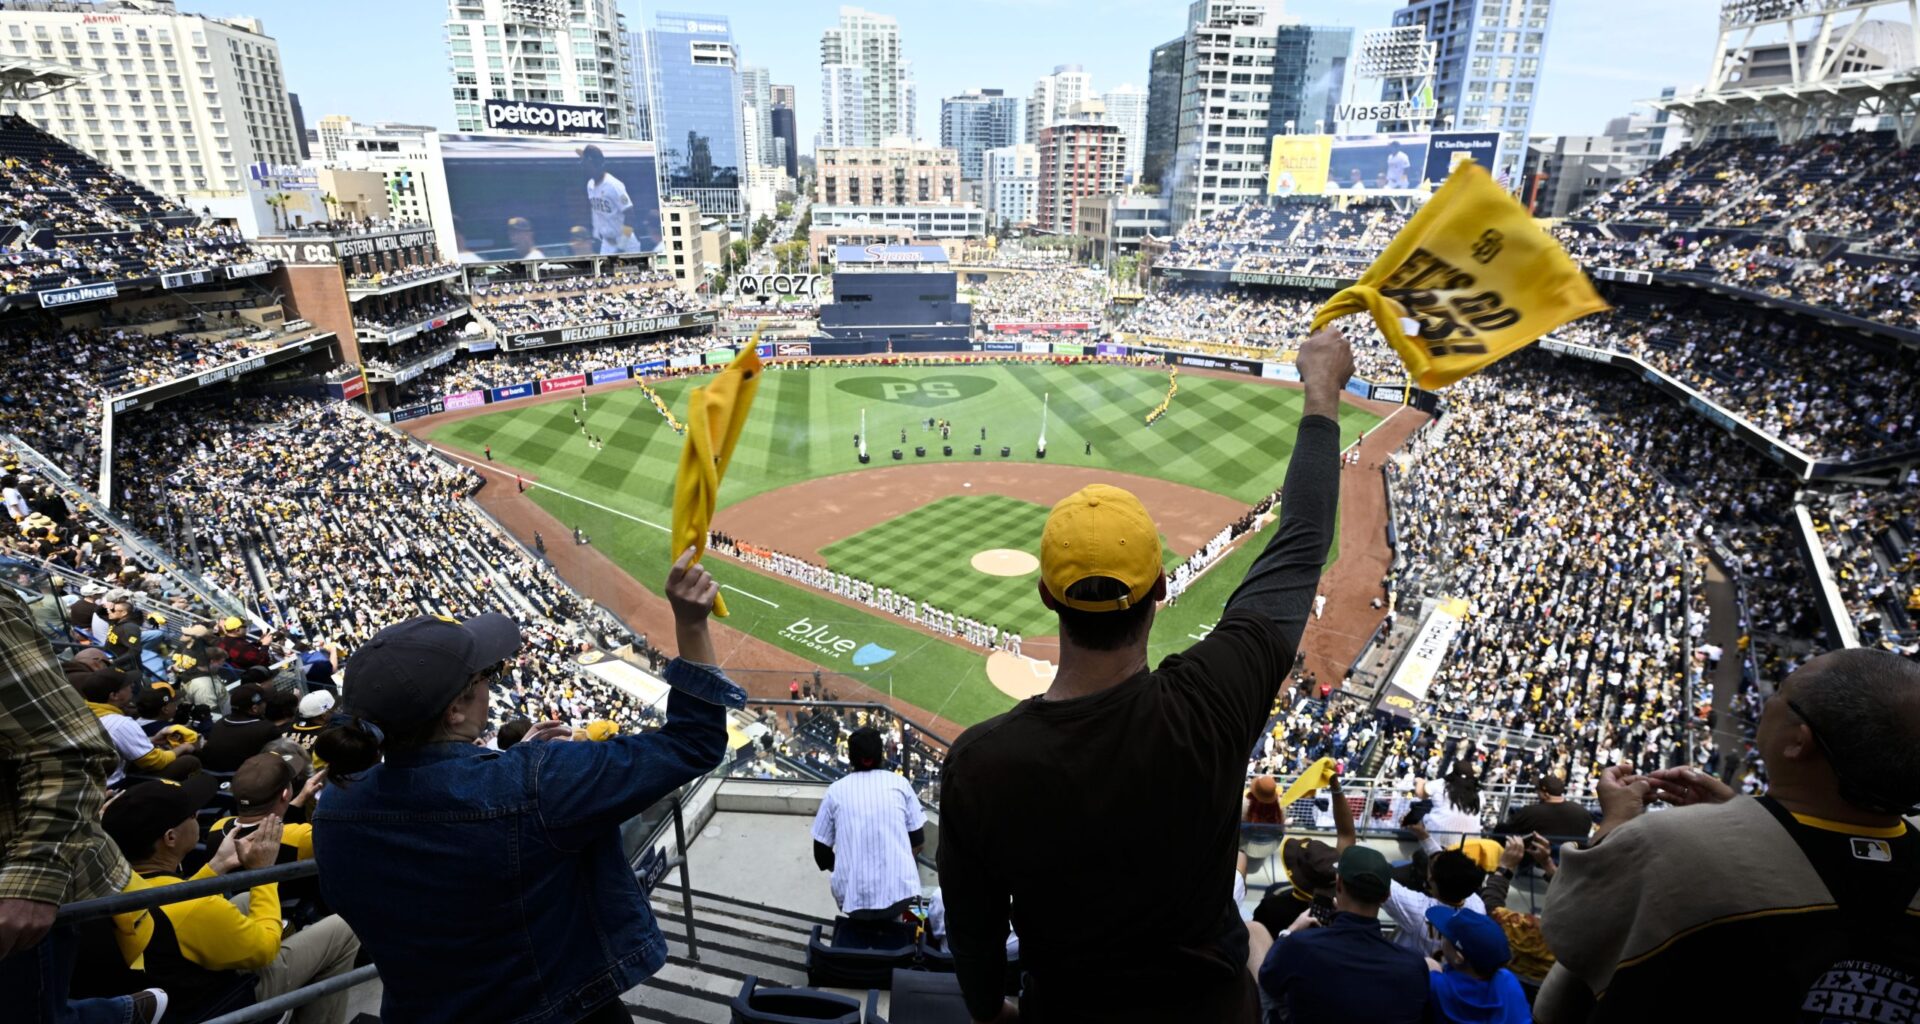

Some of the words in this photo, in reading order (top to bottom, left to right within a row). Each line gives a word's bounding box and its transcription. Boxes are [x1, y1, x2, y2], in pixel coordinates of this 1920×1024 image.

[488, 102, 555, 128] petco
[556, 109, 605, 131] park
[1337, 103, 1403, 122] Viasat
[302, 243, 338, 264] CO.
[336, 239, 373, 258] WESTERN
[374, 236, 400, 252] METAL
[400, 232, 425, 248] SUPPLY
[425, 231, 438, 245] CO.
[762, 275, 822, 299] razr
[1229, 272, 1269, 284] WELCOME
[1271, 274, 1283, 285] TO
[1284, 275, 1312, 288] PETCO
[1312, 277, 1338, 289] PARK
[561, 324, 610, 342] WELCOME
[612, 321, 625, 336] TO
[625, 318, 655, 335] PETCO
[657, 315, 681, 330] PARK
[198, 368, 227, 386] WELCOME
[235, 360, 252, 375] PETCO
[881, 381, 961, 400] PS
[778, 629, 842, 659] CALIFORNIA
[785, 616, 857, 654] blue
[647, 857, 664, 889] 302
[1807, 968, 1920, 1010] EXIC
[1801, 989, 1920, 1024] ERIE
